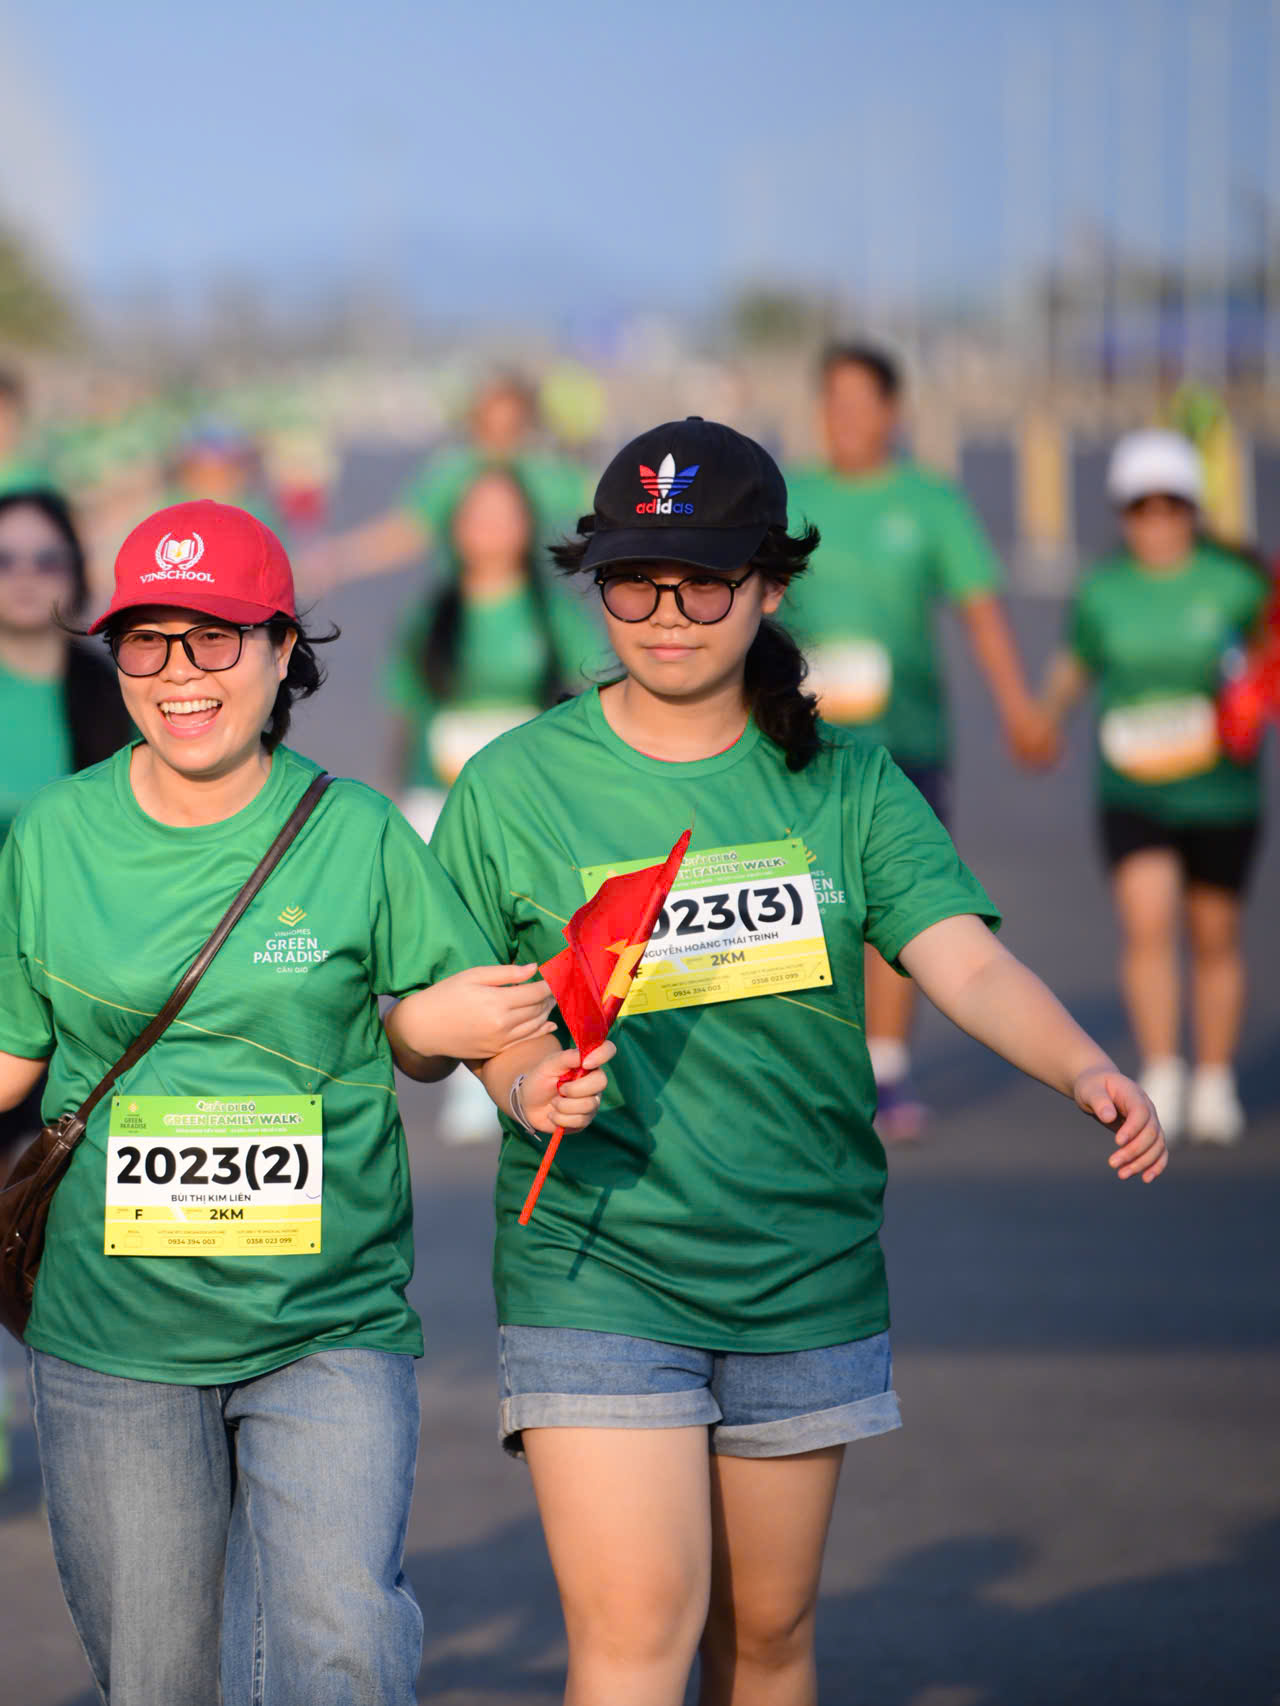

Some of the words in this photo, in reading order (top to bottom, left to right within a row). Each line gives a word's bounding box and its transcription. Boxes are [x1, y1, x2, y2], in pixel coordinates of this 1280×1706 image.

[636, 498, 694, 515] adidas
[140, 569, 215, 584] VINSCHOOL
[743, 858, 784, 870] WALK
[816, 890, 846, 904] DISE
[650, 883, 803, 940] 23(3)
[265, 937, 318, 950] GREEN
[253, 950, 329, 963] PARADISE
[711, 951, 745, 967] 2KM
[210, 1113, 256, 1124] FAMILY
[260, 1114, 297, 1124] WALK
[117, 1144, 309, 1190] 2023(2)
[171, 1192, 188, 1202] BÙI
[190, 1194, 206, 1205] THỊ
[208, 1194, 227, 1202] KIM
[229, 1192, 251, 1202] LIÊN
[135, 1208, 143, 1220] F
[209, 1208, 244, 1220] 2KM
